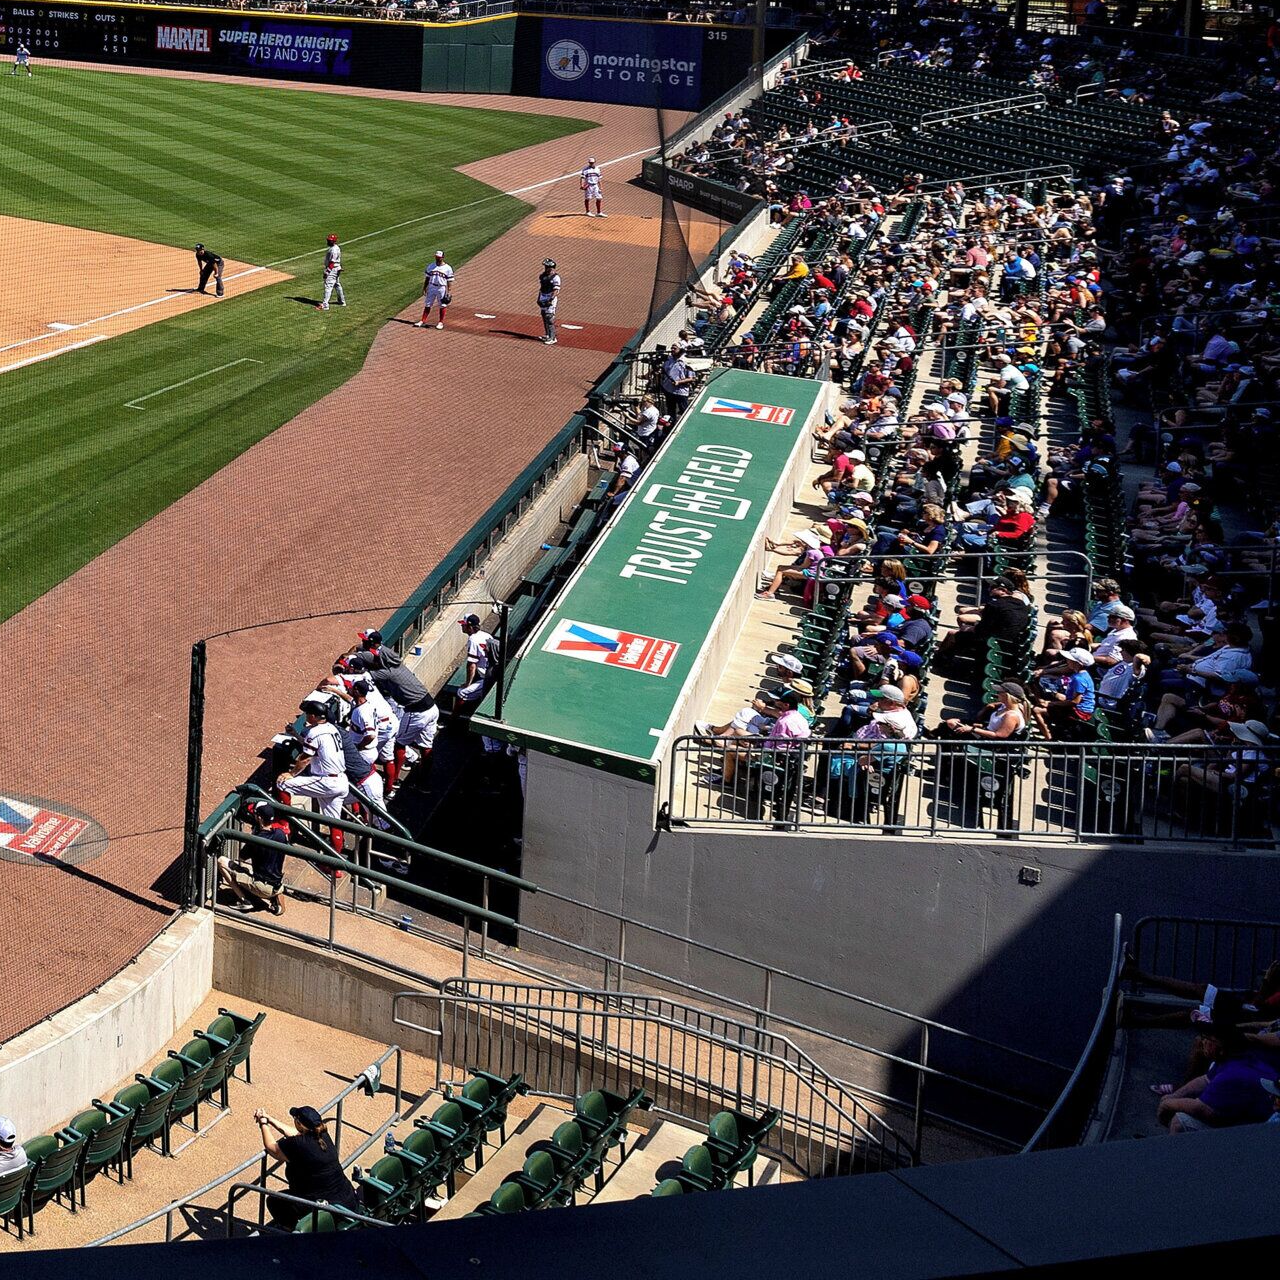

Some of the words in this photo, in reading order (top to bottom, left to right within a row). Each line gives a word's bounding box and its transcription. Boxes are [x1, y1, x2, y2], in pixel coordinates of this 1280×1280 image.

[12, 8, 35, 17] BALLS
[48, 10, 79, 20] STRIKES
[95, 14, 116, 22] OUTS
[156, 25, 211, 52] MARVEL
[218, 29, 258, 45] SUPER
[259, 32, 292, 47] HERO
[294, 35, 350, 52] KNIGHTS
[707, 31, 728, 41] 315
[248, 45, 271, 59] 7/13
[274, 48, 298, 61] AND
[302, 50, 322, 64] 9/3
[593, 53, 697, 72] morningstar
[593, 68, 694, 87] STORAGE
[668, 174, 694, 191] SHARP
[677, 444, 753, 492] FIELD
[619, 510, 718, 585] TRUIST
[20, 817, 62, 849] Valvoline
